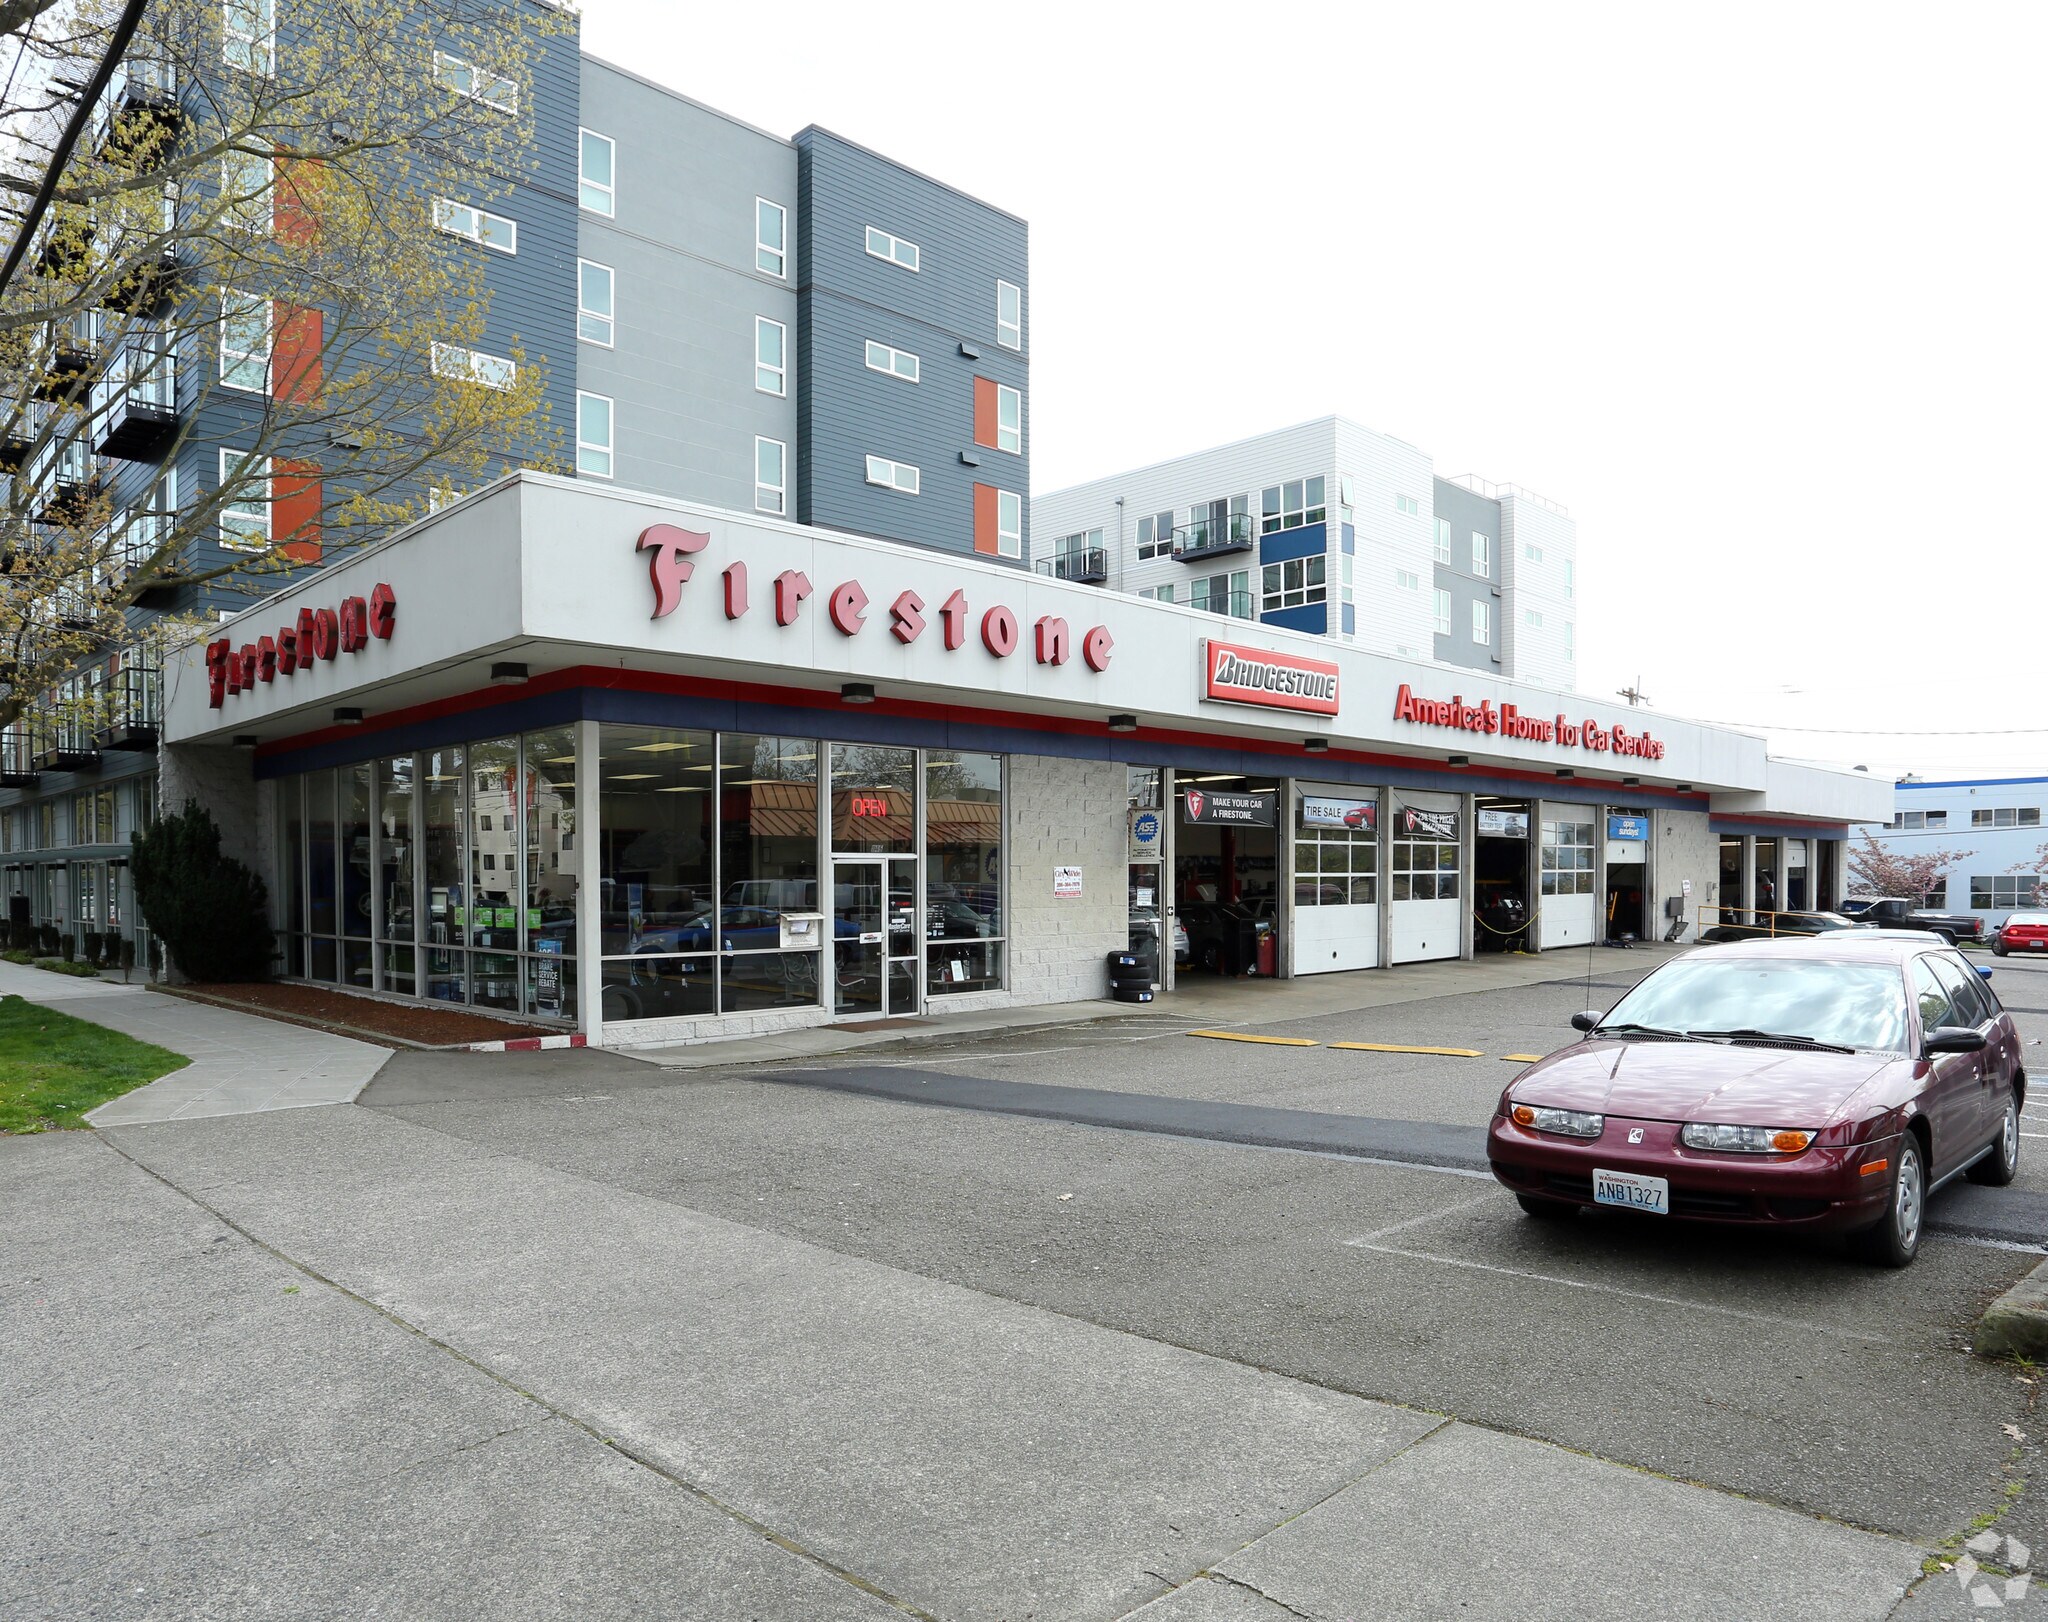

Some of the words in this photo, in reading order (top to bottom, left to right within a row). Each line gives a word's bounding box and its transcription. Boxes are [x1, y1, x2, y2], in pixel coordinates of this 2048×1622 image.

[635, 523, 1115, 672] Firestone
[205, 583, 396, 709] Firestone
[1215, 652, 1336, 699] BRIDGESTONE
[1393, 684, 1498, 734] America's
[1500, 703, 1554, 742] Home
[1556, 714, 1581, 746] for
[1582, 719, 1612, 751] Car
[1612, 724, 1665, 760] Service
[852, 798, 887, 817] OPEN
[1212, 797, 1230, 807] MAKE
[1232, 799, 1249, 808] YOUR
[1250, 800, 1263, 809] CAR
[1212, 809, 1218, 818] A
[1306, 805, 1321, 816] TIRE
[1323, 807, 1341, 817] SALE
[1485, 811, 1498, 822] FREE
[1137, 821, 1156, 833] ASE
[538, 970, 558, 980] SERVICE
[538, 978, 556, 988] REBATE
[1599, 1174, 1639, 1186] WASHINGTON
[1598, 1181, 1662, 1207] ANB1327
